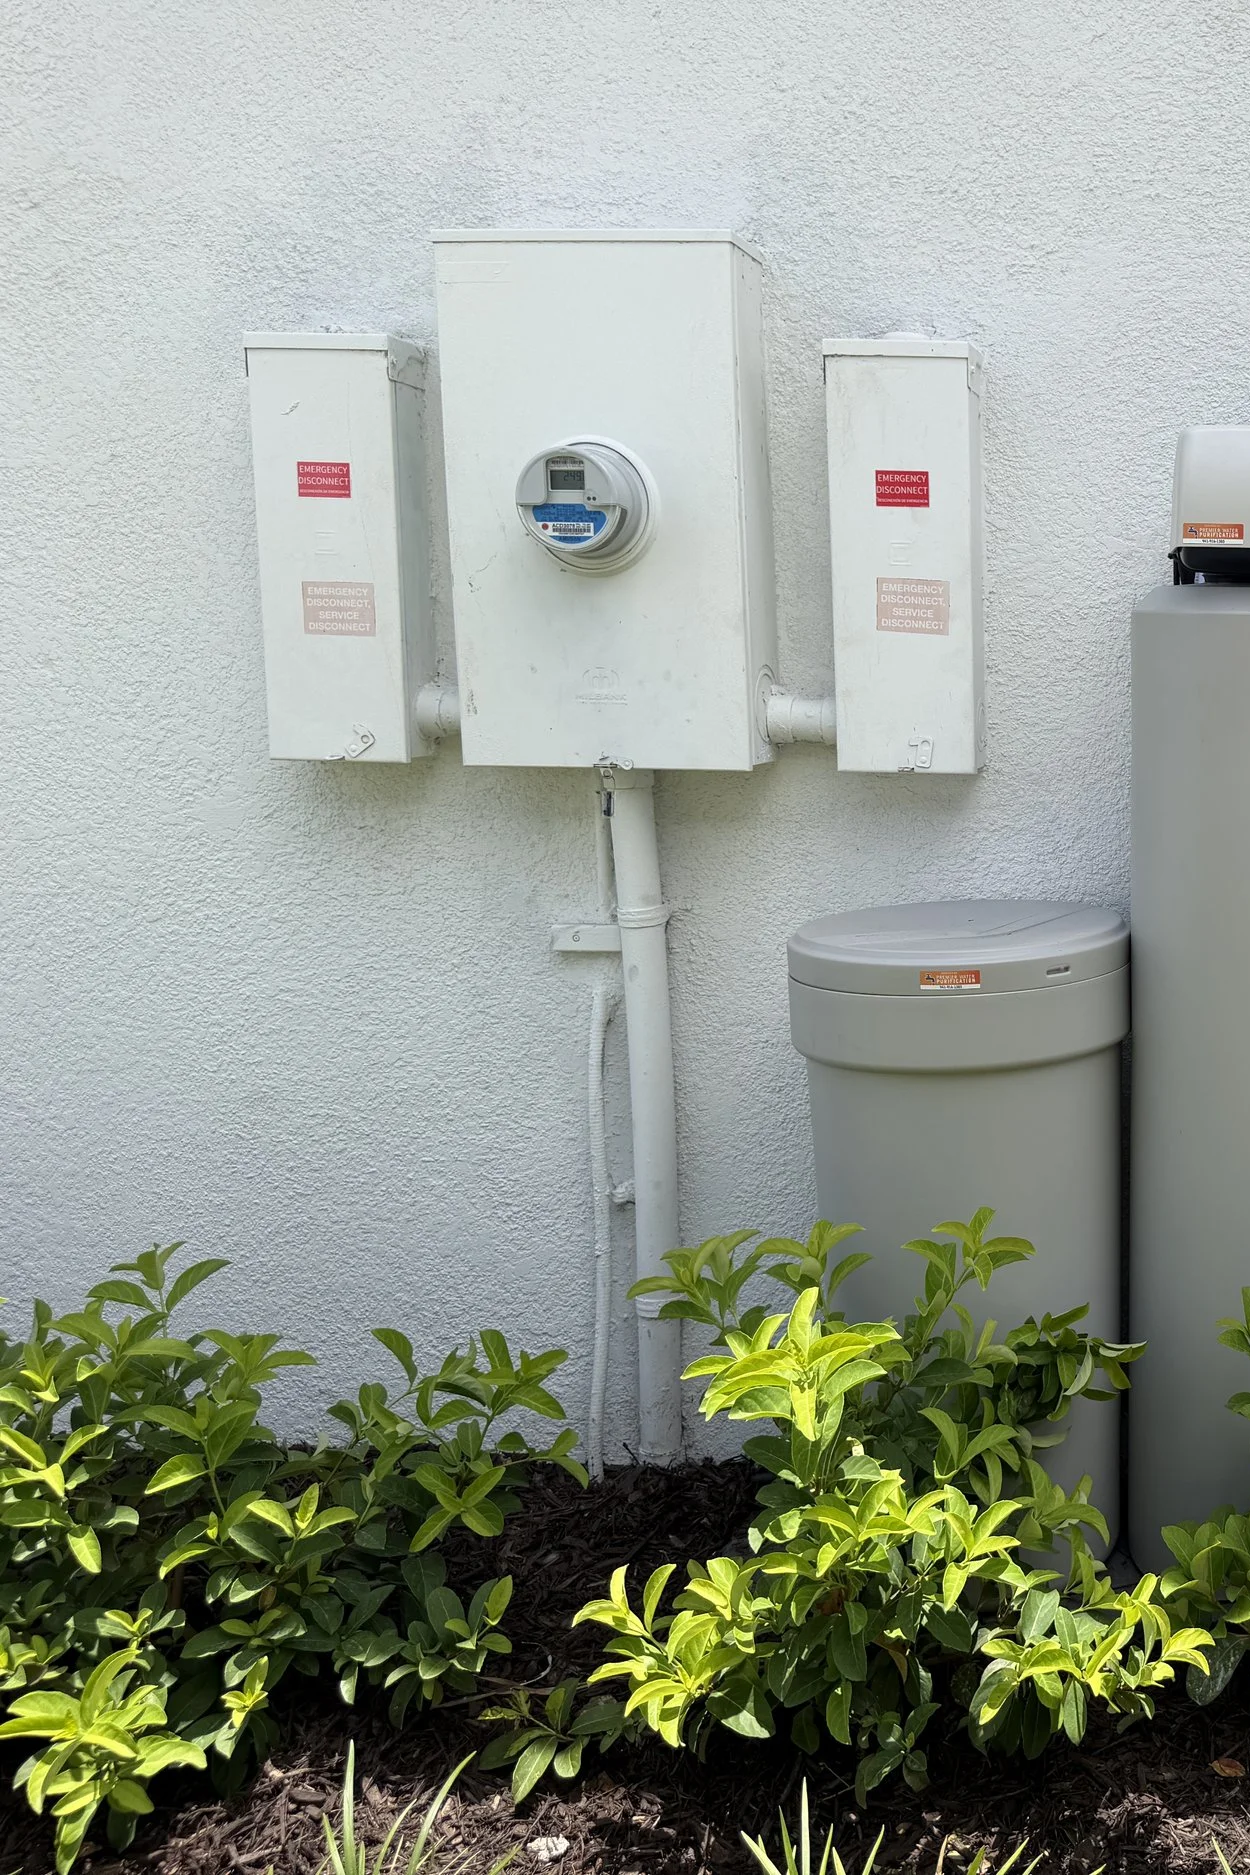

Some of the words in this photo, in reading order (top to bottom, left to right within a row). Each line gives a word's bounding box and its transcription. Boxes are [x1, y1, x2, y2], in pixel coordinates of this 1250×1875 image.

[299, 465, 348, 474] EMERGENCY
[298, 476, 349, 486] DISCONNECT
[877, 474, 927, 483] EMERGENCY
[876, 485, 928, 495] DISCONNECT
[307, 586, 368, 596] EMERGENCY
[882, 583, 944, 594] EMERGENCY
[319, 610, 360, 620] SERVICE
[892, 607, 934, 618] SERVICE
[308, 622, 371, 632] DISCONNECT
[881, 618, 945, 630] DISCONNECT
